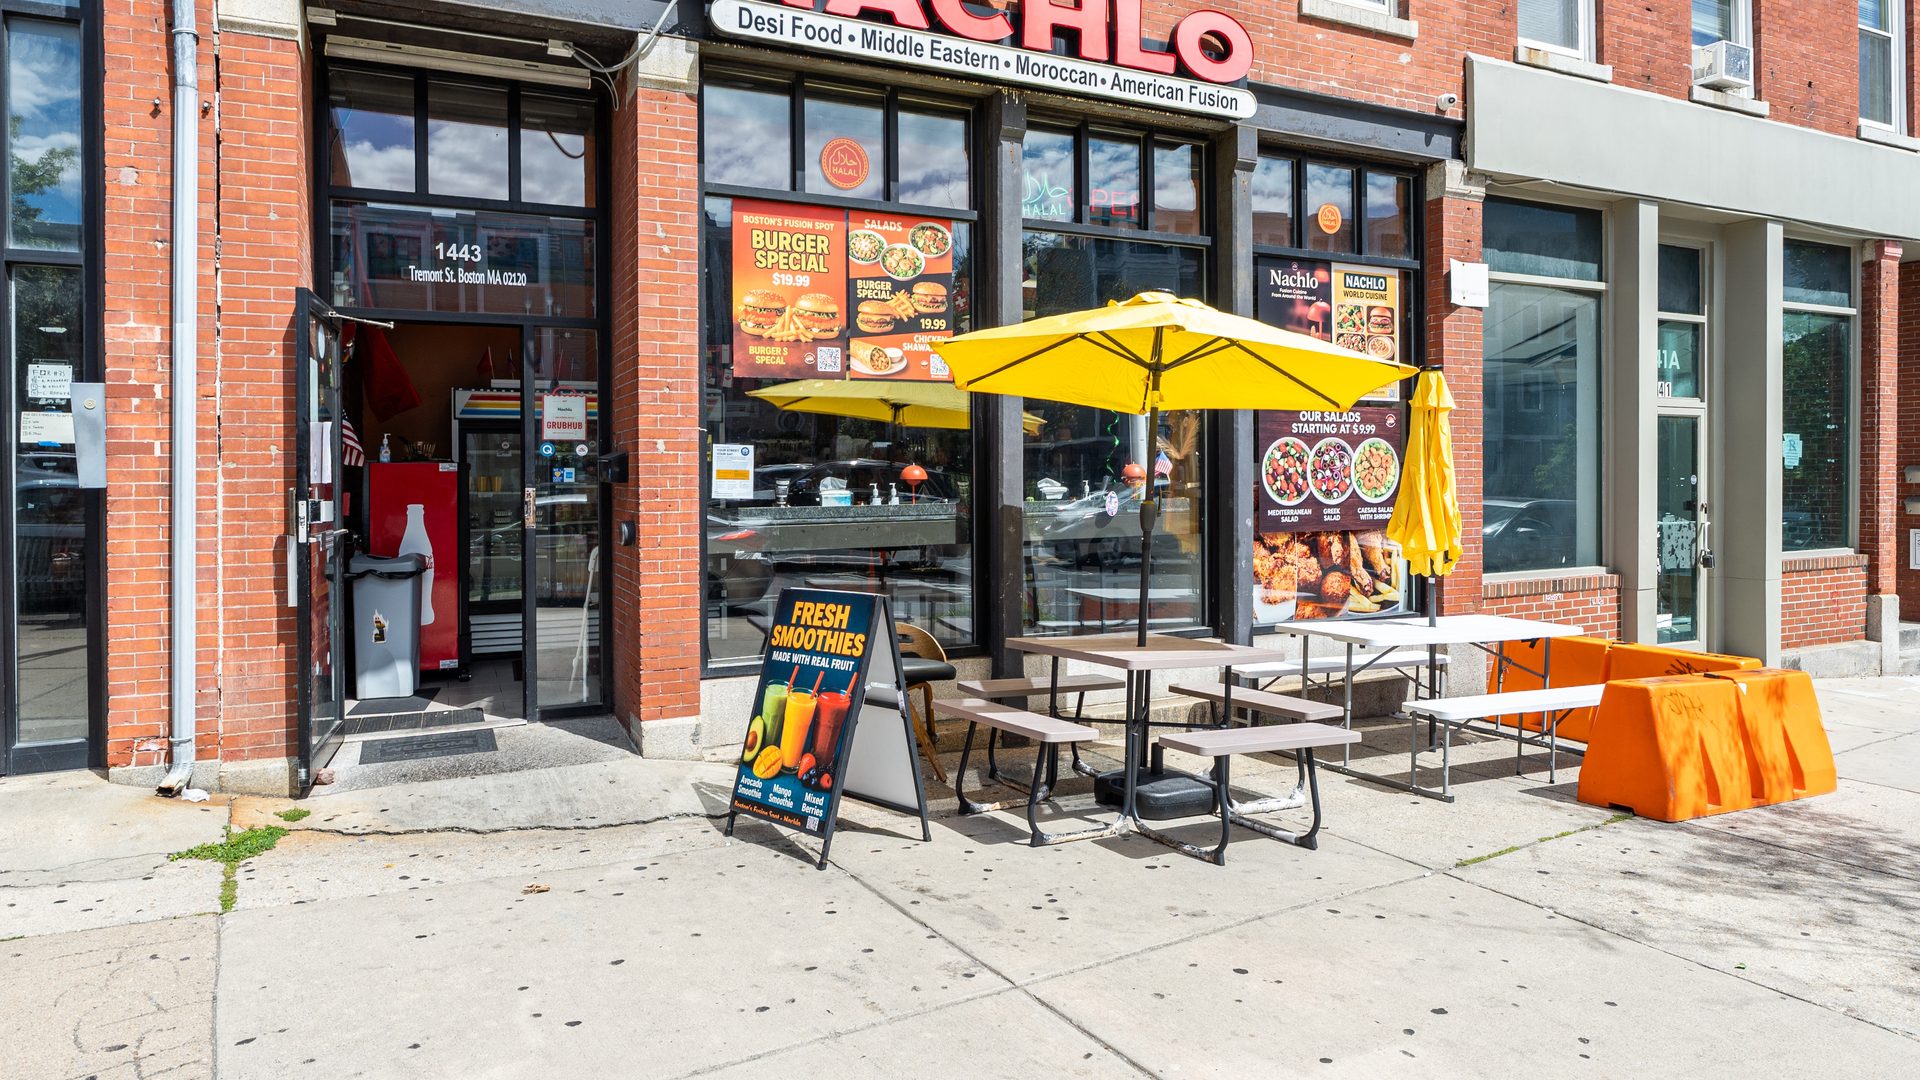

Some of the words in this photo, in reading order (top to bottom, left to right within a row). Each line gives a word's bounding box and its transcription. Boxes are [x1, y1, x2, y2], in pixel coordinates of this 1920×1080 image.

[738, 6, 784, 35] Desi
[791, 16, 842, 45] Food
[861, 27, 924, 57] Middle
[929, 40, 999, 70] Eastern
[1016, 54, 1098, 87] Moroccan
[1110, 72, 1184, 102] American
[1189, 85, 1238, 111] Fusion
[832, 166, 858, 177] HALAL
[1021, 204, 1066, 216] HALAL
[742, 214, 782, 227] BOSTON'S
[784, 218, 813, 229] FUSION
[815, 221, 835, 231] SPOT
[864, 218, 903, 232] SALADS
[751, 228, 830, 255] BURGER
[435, 242, 482, 262] 1443
[754, 249, 829, 273] SPECIAL
[409, 265, 443, 282] Tremont
[444, 267, 456, 283] St.
[458, 267, 485, 285] Boston
[487, 269, 502, 285] MA
[502, 271, 527, 287] 02120
[772, 272, 810, 287] $19.99
[1269, 269, 1319, 290] Nachlo
[1345, 275, 1386, 290] NACHLO
[856, 279, 892, 291] BURGER
[856, 289, 892, 300] SPECIAL
[1343, 290, 1365, 299] WORLD
[1365, 291, 1388, 301] CUISINE
[919, 318, 947, 330] 19.99
[749, 345, 780, 355] BURGER
[902, 342, 934, 352] SHAWA
[755, 355, 786, 365] SPECAL
[1299, 411, 1322, 421] OUR
[1323, 411, 1361, 423] SALADS
[546, 421, 583, 430] GRUBHUB
[1291, 423, 1337, 434] STARTING
[1339, 424, 1352, 434] AT
[1357, 506, 1377, 514] CAESAR
[791, 601, 851, 629] FRESH
[770, 624, 866, 657] SMOOTHIES
[771, 650, 791, 663] MADE
[792, 652, 811, 666] WITH
[811, 655, 830, 668] REAL
[831, 658, 855, 672] FRUIT
[740, 775, 763, 789] Avocado
[737, 784, 762, 799] Smoothie
[772, 783, 792, 797] Mango
[768, 793, 794, 808] Smoothie
[804, 791, 824, 806] Mixed
[801, 803, 824, 817] Berries
